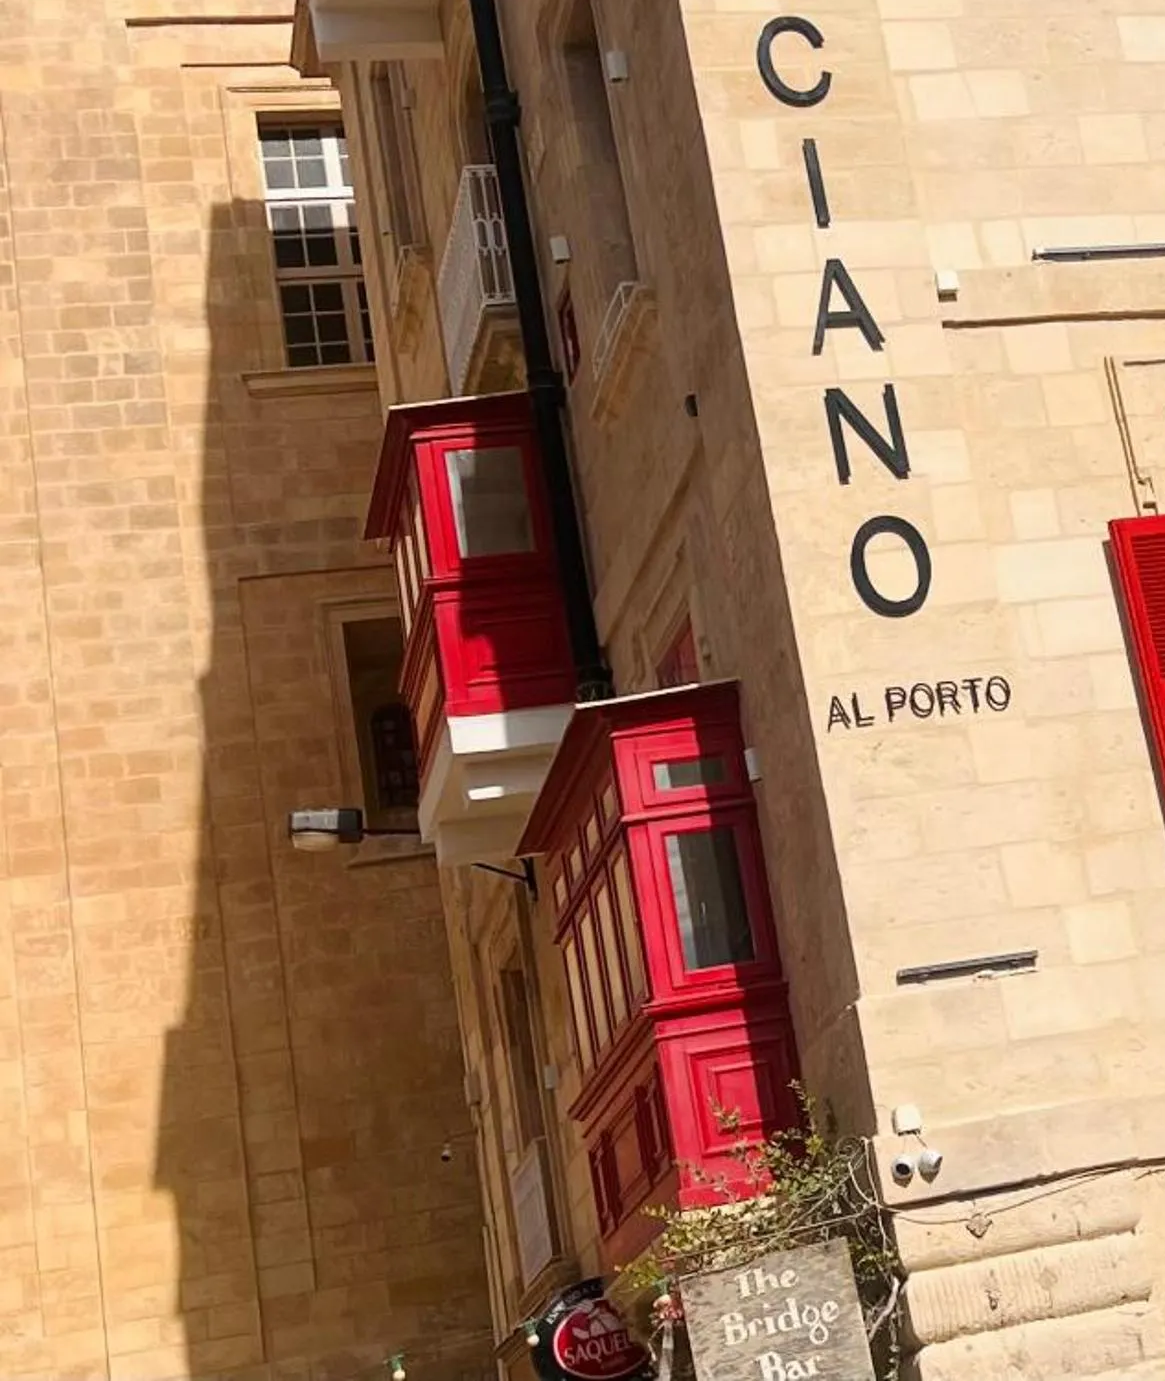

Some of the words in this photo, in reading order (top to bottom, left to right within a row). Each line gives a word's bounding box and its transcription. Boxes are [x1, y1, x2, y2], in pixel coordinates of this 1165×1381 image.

[827, 692, 875, 733] AL
[885, 675, 1012, 722] PORTO
[733, 1268, 799, 1299] The
[719, 1297, 840, 1345] Bridge
[752, 1350, 820, 1381] Bar
